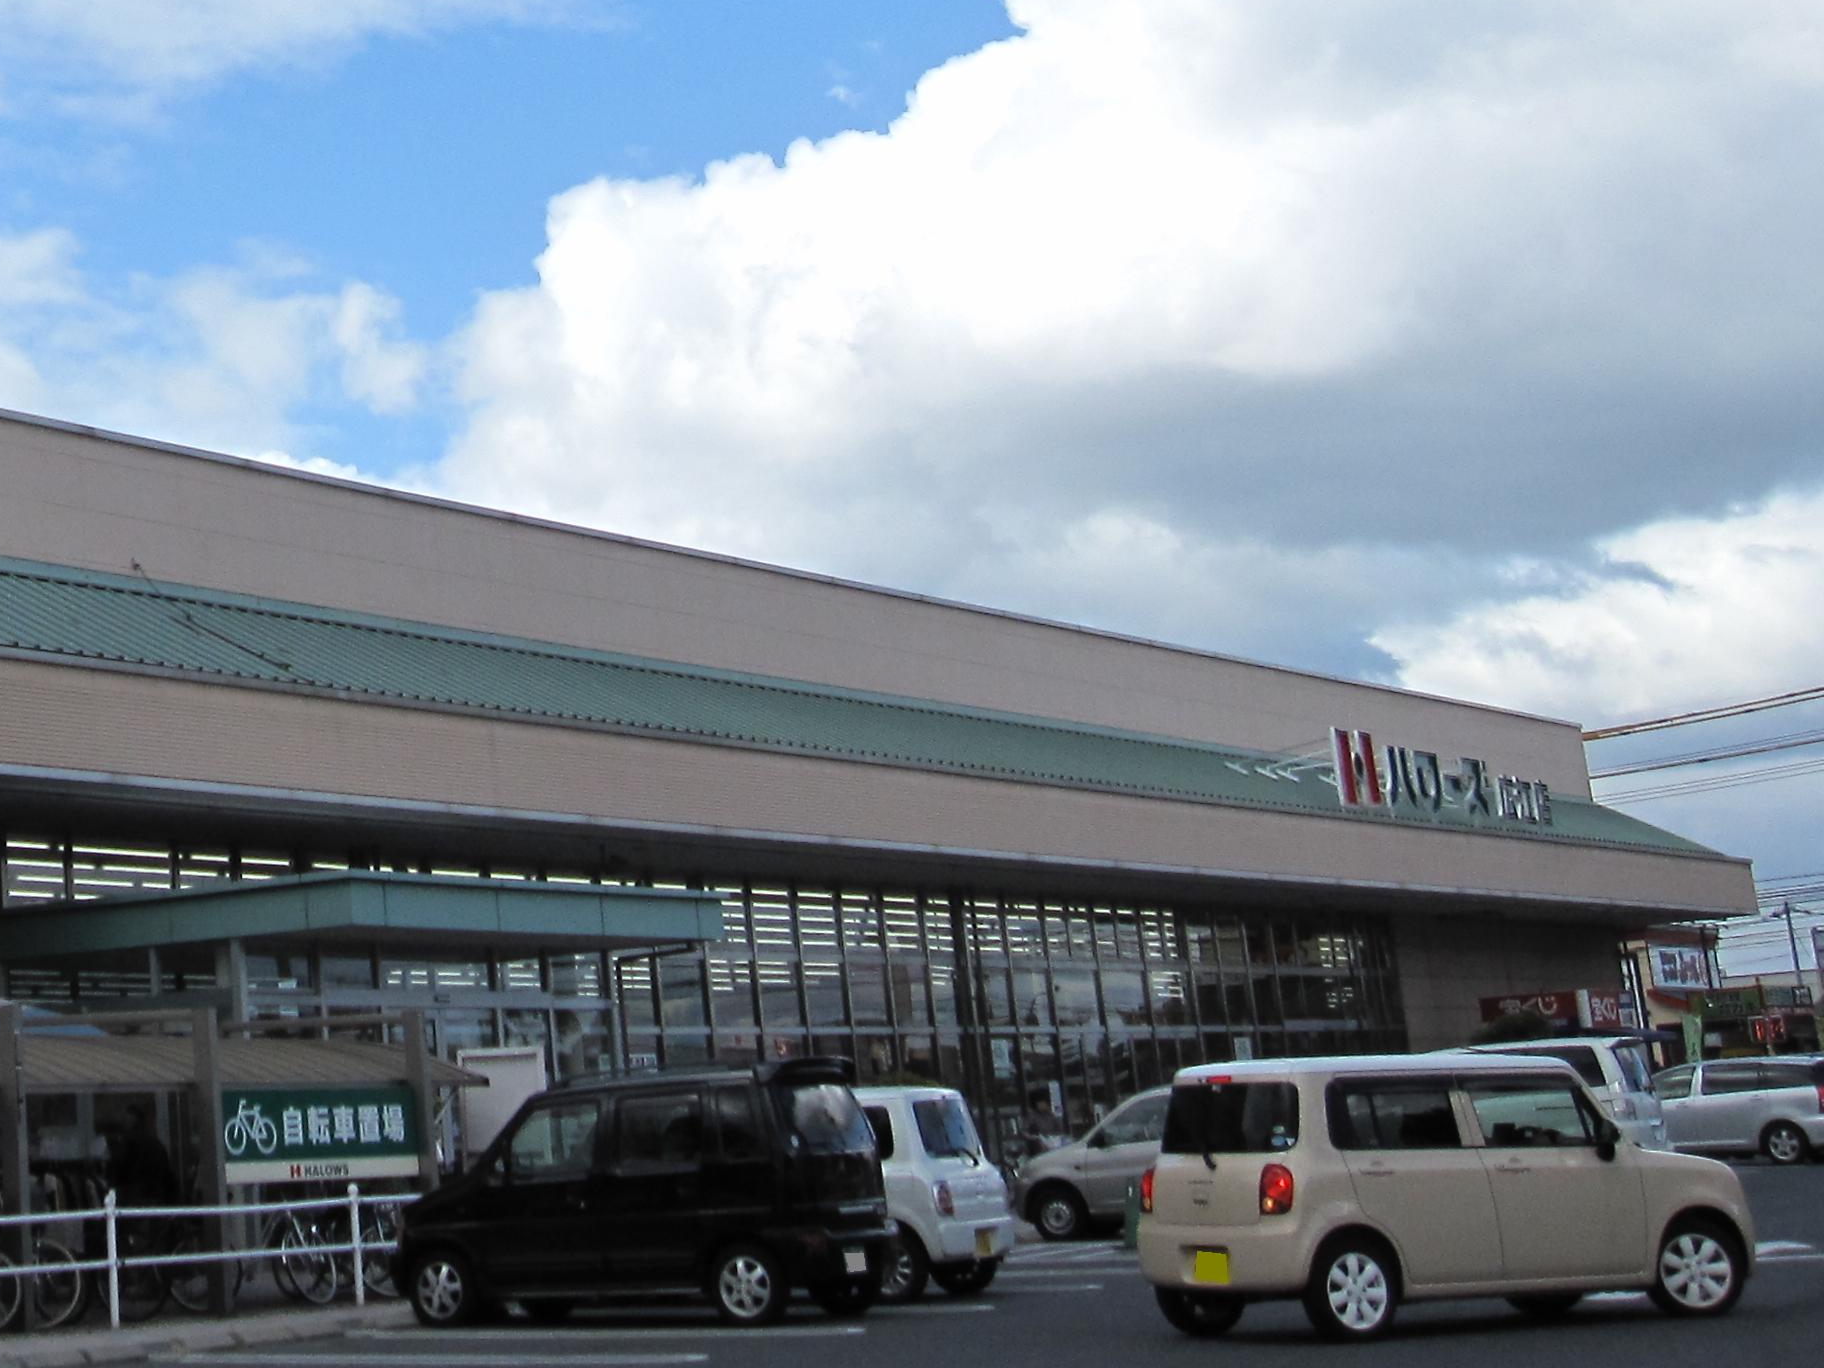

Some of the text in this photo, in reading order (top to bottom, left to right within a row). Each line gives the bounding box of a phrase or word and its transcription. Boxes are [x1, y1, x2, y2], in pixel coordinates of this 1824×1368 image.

[283, 1105, 405, 1147] 自転車置場
[305, 1164, 350, 1177] HALOWS
